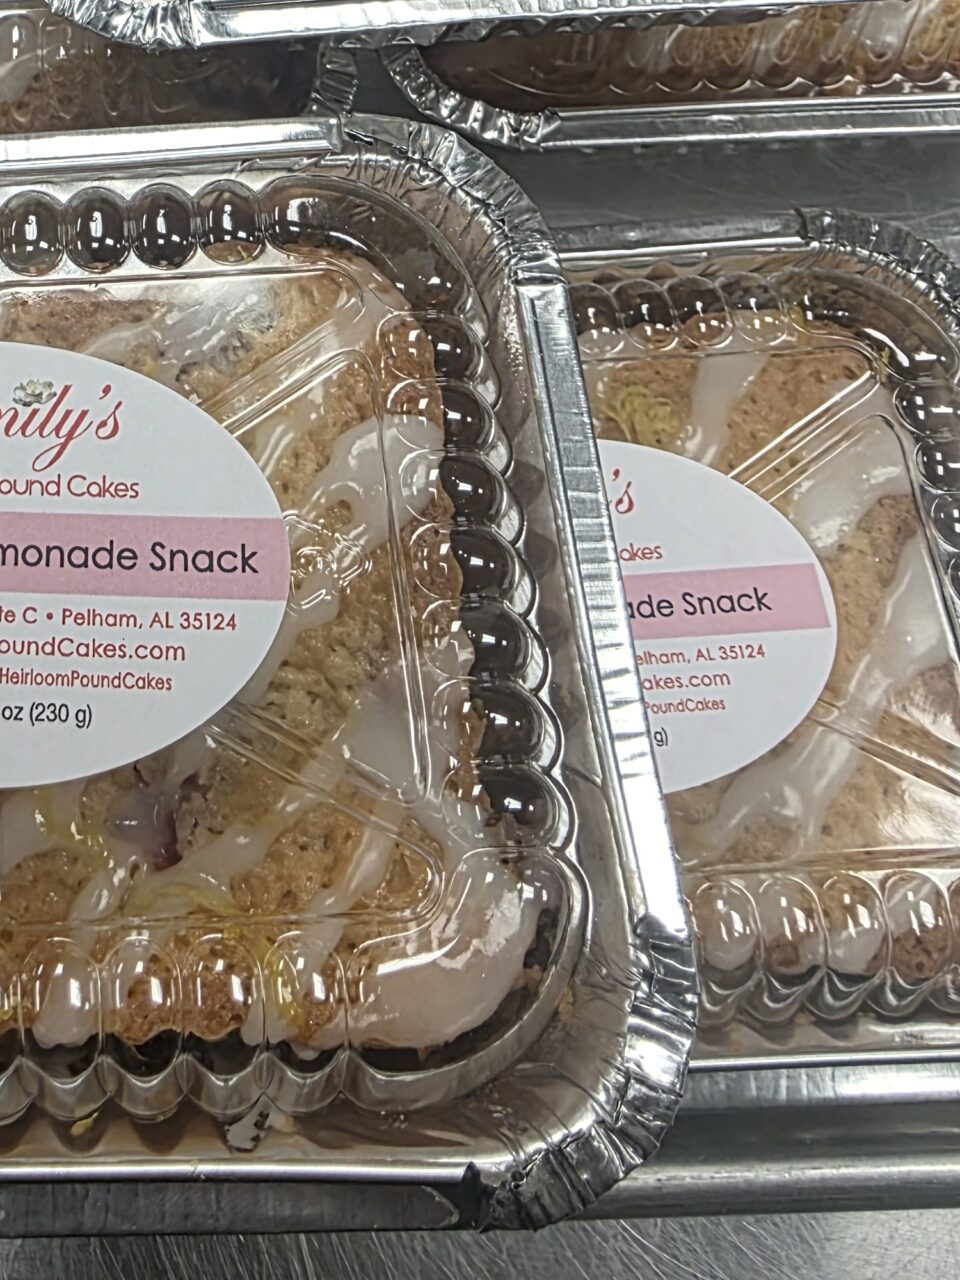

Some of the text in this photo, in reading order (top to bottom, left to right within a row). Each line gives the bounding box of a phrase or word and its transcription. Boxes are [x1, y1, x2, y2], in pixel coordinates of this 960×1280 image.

[66, 474, 140, 499] Cakes
[149, 541, 259, 574] Snack
[619, 543, 663, 562] akes
[683, 587, 772, 617] Snack
[23, 606, 38, 624] C
[61, 607, 142, 629] Pelham,
[149, 610, 174, 629] AL
[179, 611, 237, 631] 35124
[635, 643, 766, 666] elham, AL 35124
[641, 671, 731, 691] akes.com
[1, 704, 24, 721] oz
[29, 701, 70, 727] (230
[75, 703, 93, 729] g)
[653, 727, 669, 747] g)
